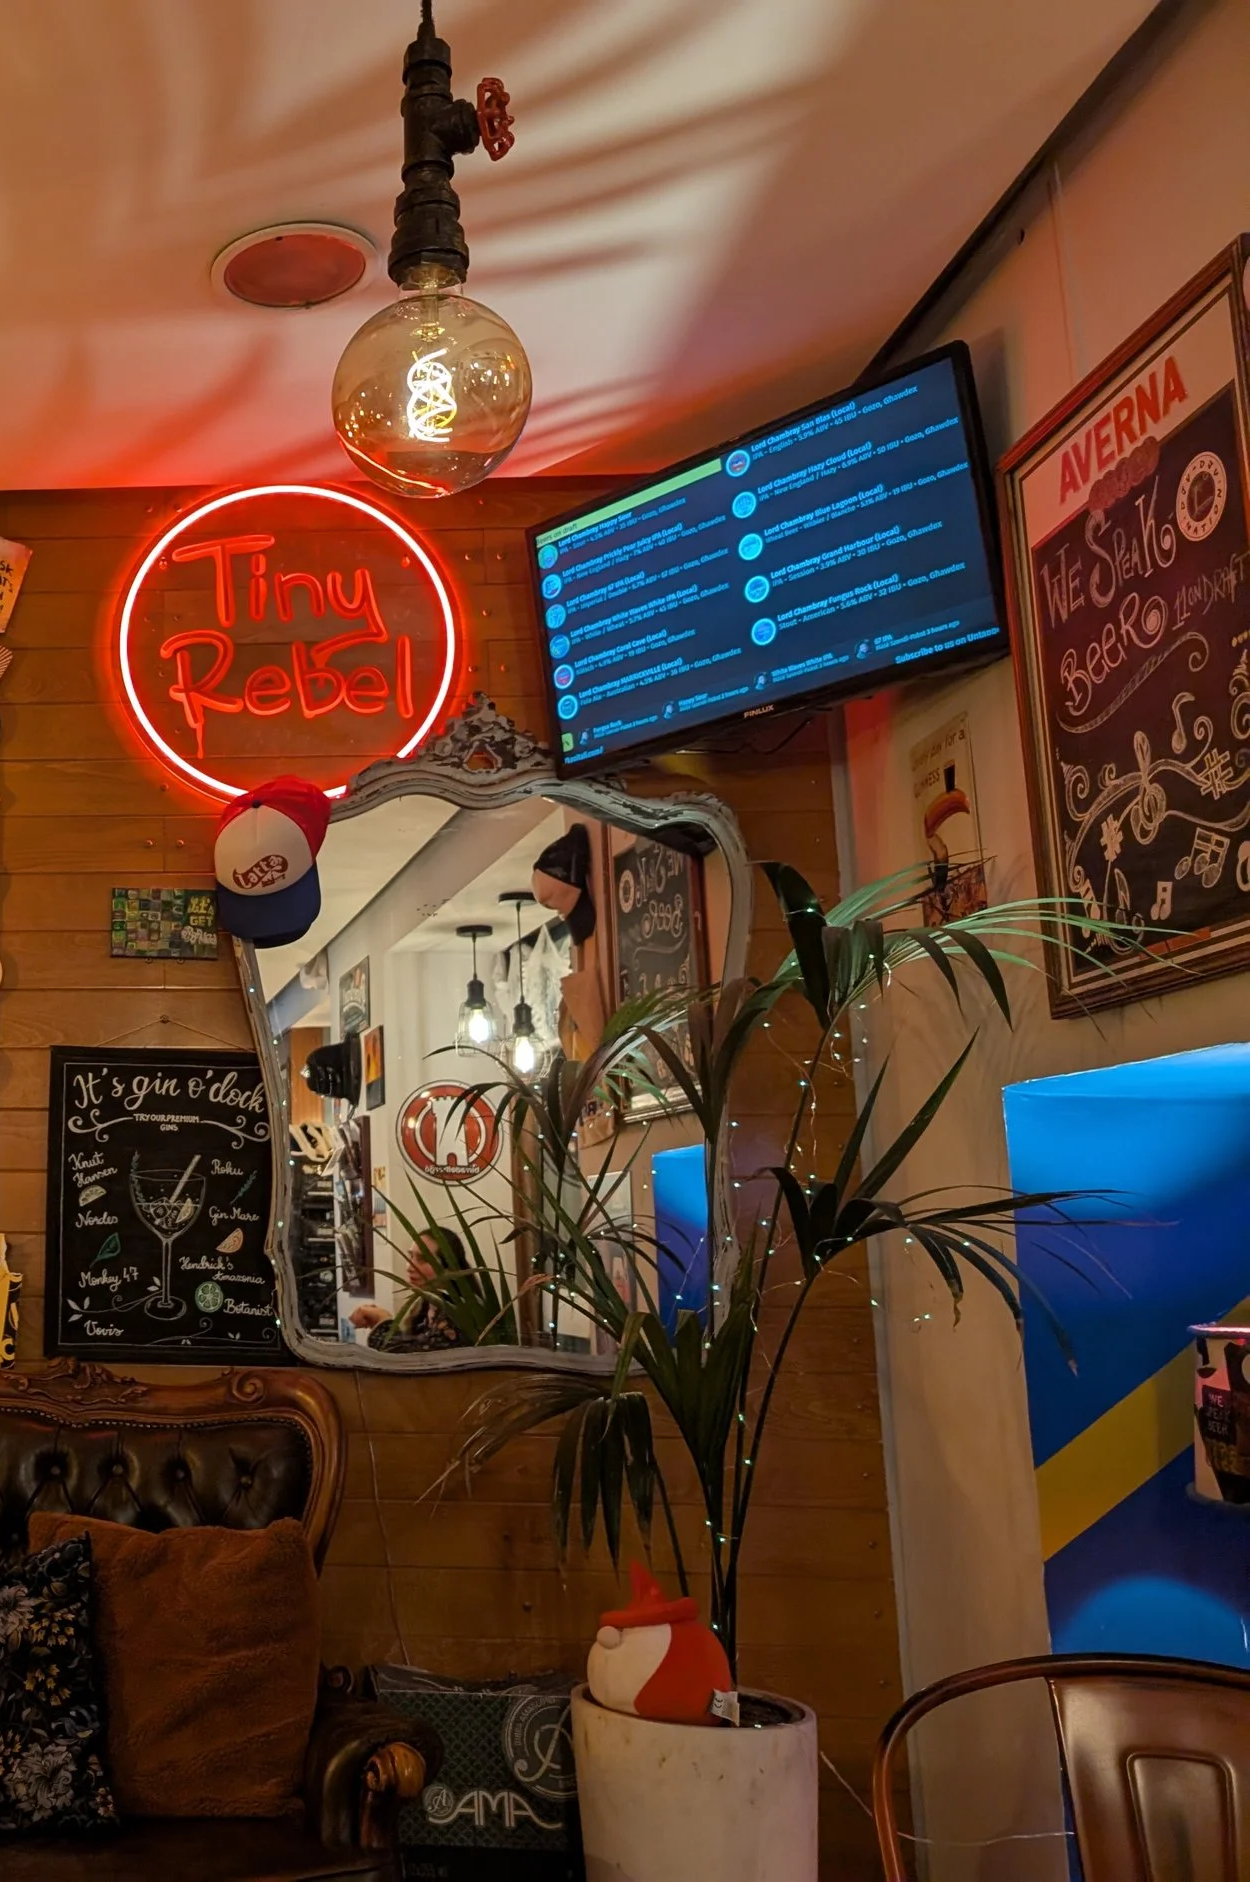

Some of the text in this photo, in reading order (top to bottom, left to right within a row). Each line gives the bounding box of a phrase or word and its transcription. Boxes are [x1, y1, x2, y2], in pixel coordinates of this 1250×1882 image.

[1059, 356, 1188, 506] AVERNA
[171, 534, 388, 660] Tiny
[1040, 543, 1085, 629] WE
[160, 629, 414, 759] Rebel
[73, 1067, 125, 1109] It's
[124, 1071, 181, 1111] gin
[133, 1113, 200, 1123] TRY OUR PREMIUM
[160, 1123, 179, 1132] GINS
[75, 1205, 260, 1228] Nordes Gin Mare
[178, 1255, 235, 1271] Hendrick's
[78, 1268, 122, 1292] Monkey
[122, 1266, 139, 1282] 47
[222, 1297, 274, 1317] Botanist
